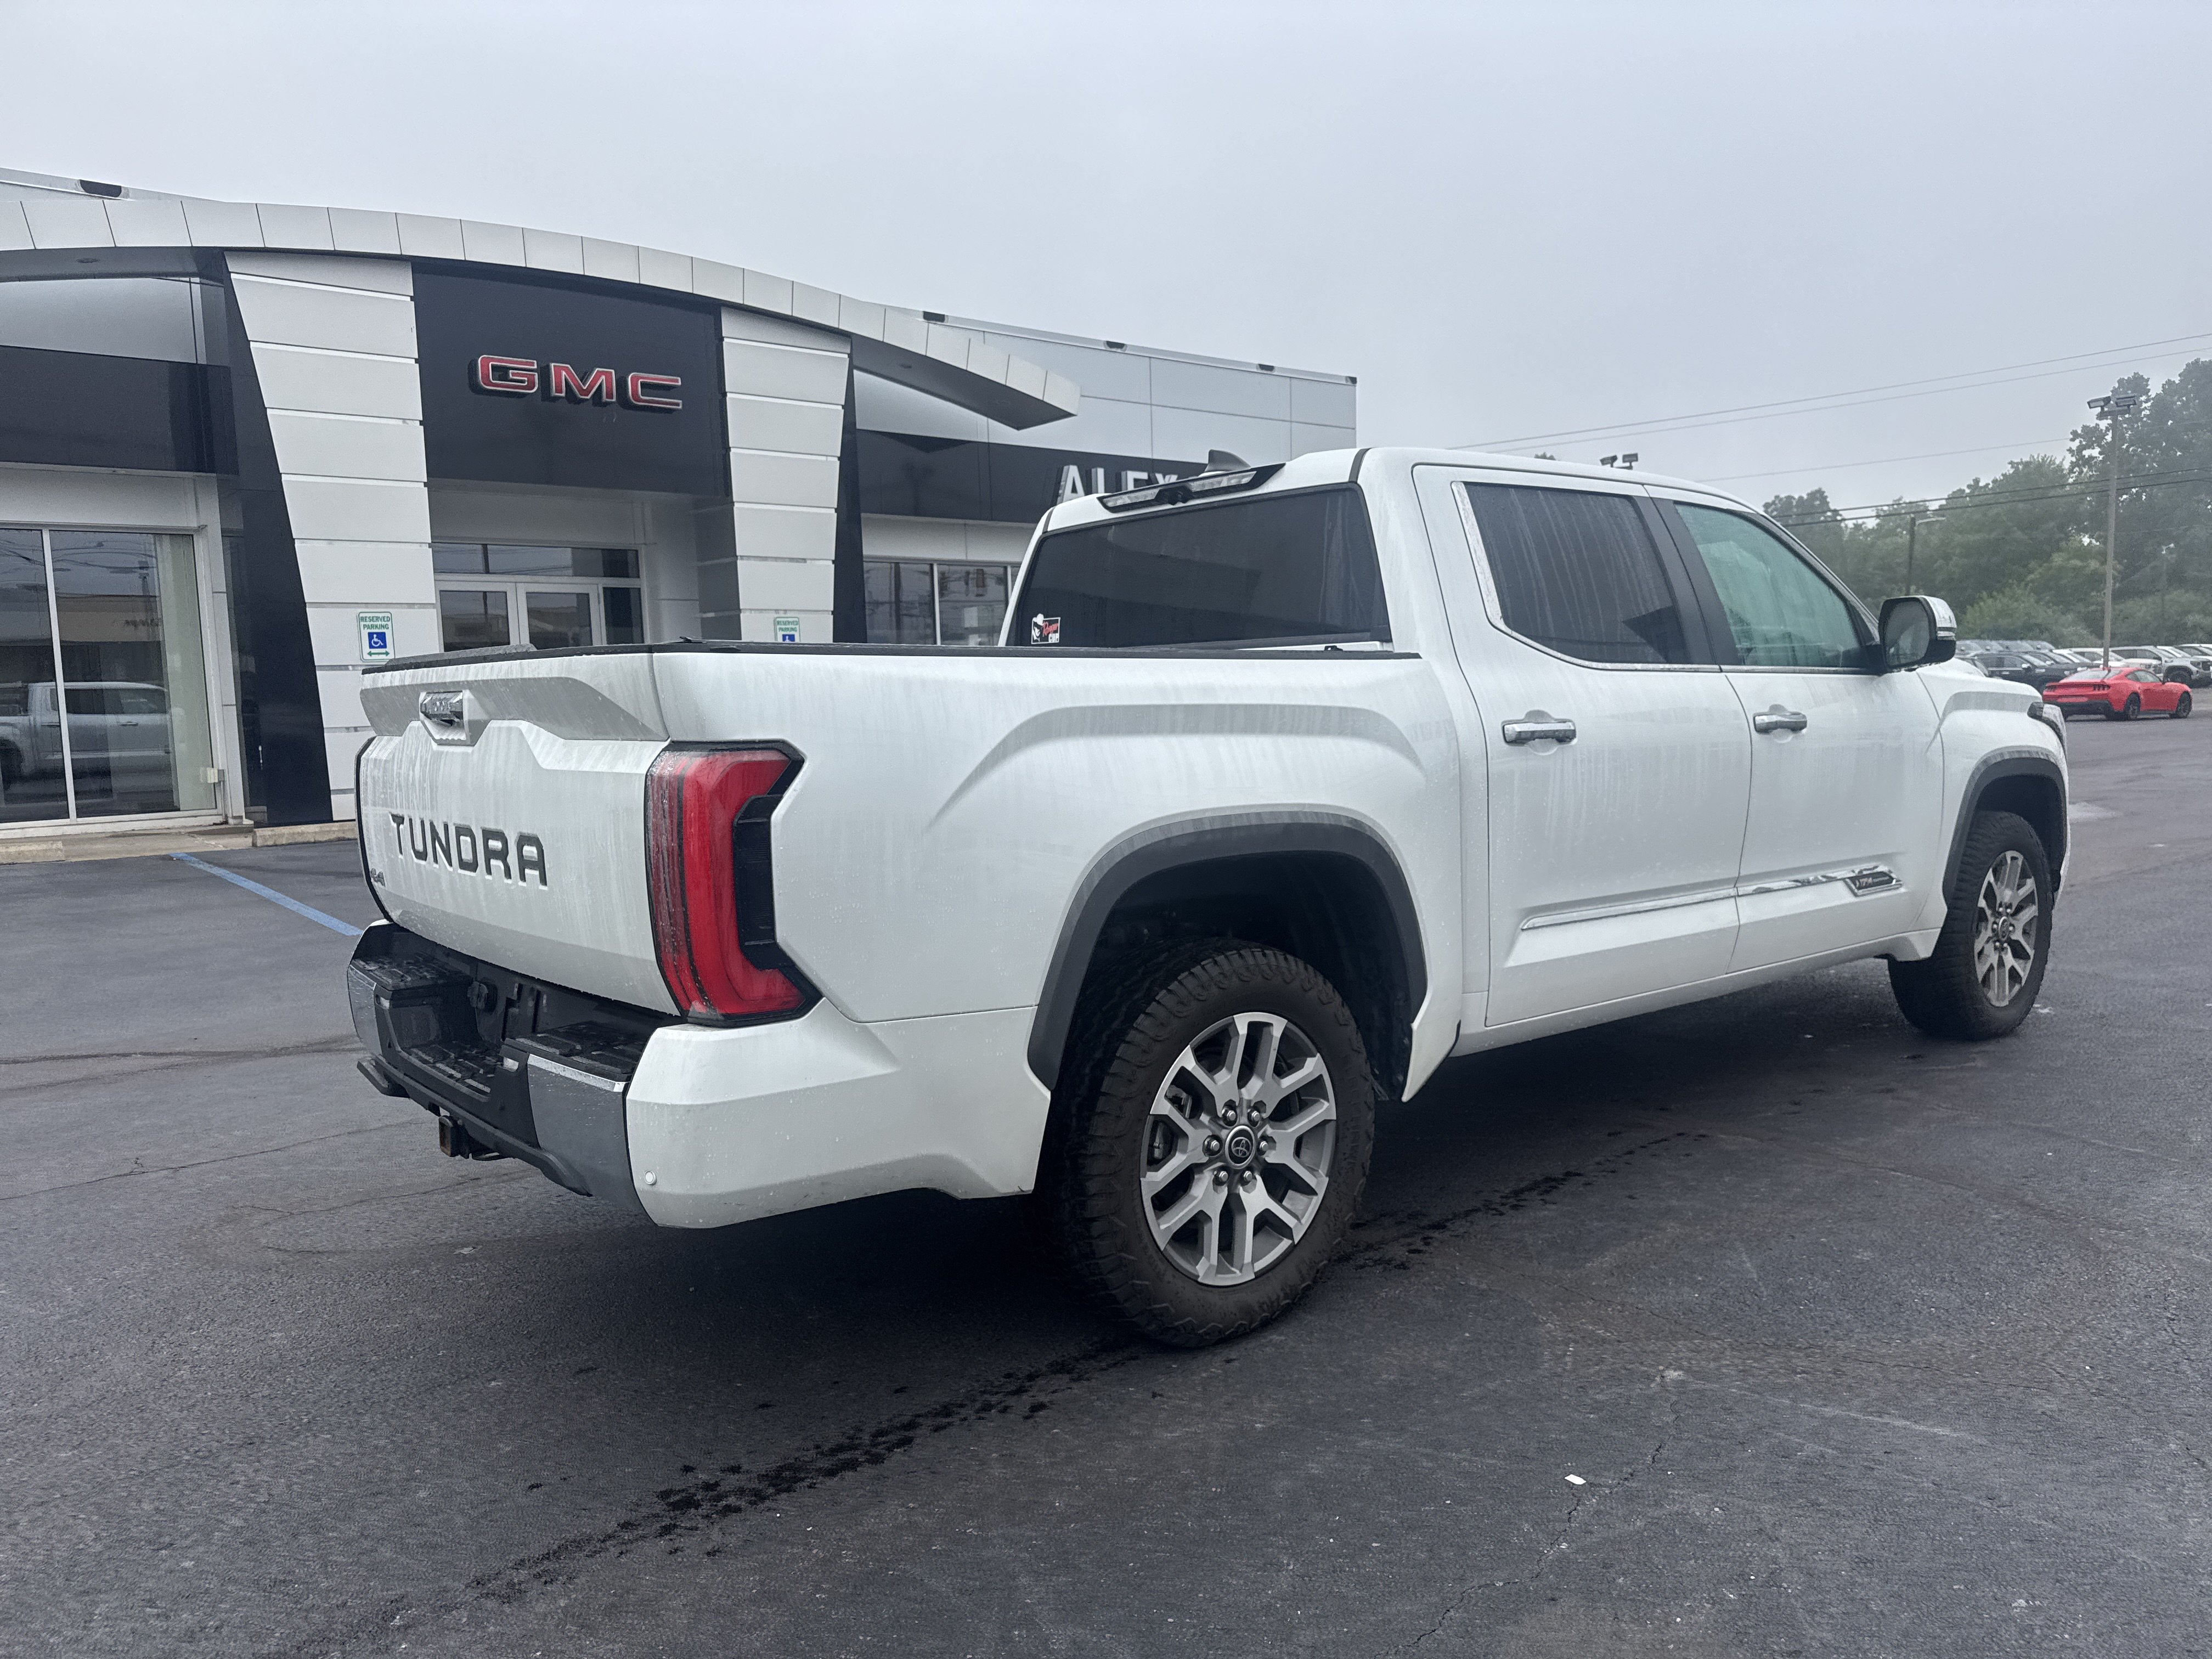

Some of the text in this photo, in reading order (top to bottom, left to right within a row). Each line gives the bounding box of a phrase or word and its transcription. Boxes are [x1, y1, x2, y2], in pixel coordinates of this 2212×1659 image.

[478, 354, 682, 409] GMC
[1058, 465, 1178, 504] AL
[388, 812, 548, 887] TUNDRA
